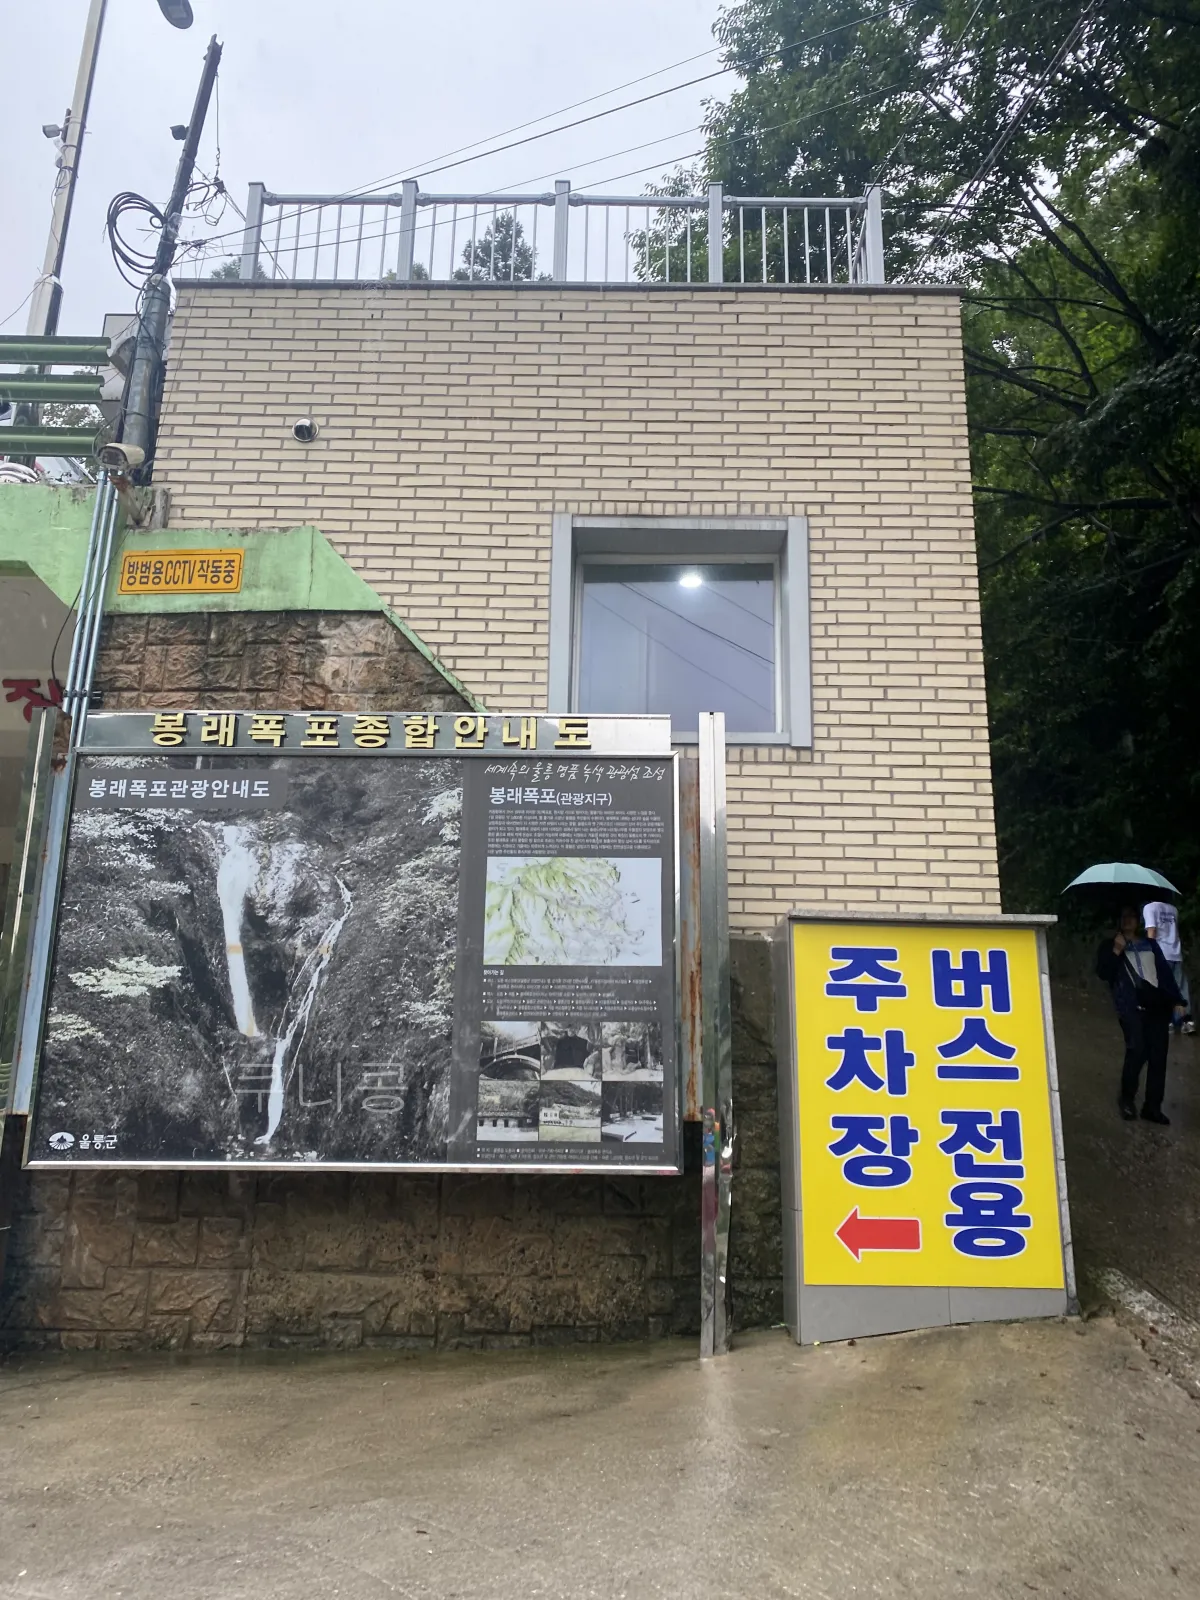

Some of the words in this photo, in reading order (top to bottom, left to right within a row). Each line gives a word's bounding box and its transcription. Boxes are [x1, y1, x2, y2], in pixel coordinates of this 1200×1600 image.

[148, 713, 593, 750] 봉래폭포종합안내도
[556, 763, 580, 782] 명품
[583, 763, 605, 784] 녹색
[642, 765, 666, 781] 조성
[88, 777, 271, 799] 봉래폭포관광안내도
[824, 945, 921, 1189] 주차장
[78, 1133, 118, 1150] 울릉군
